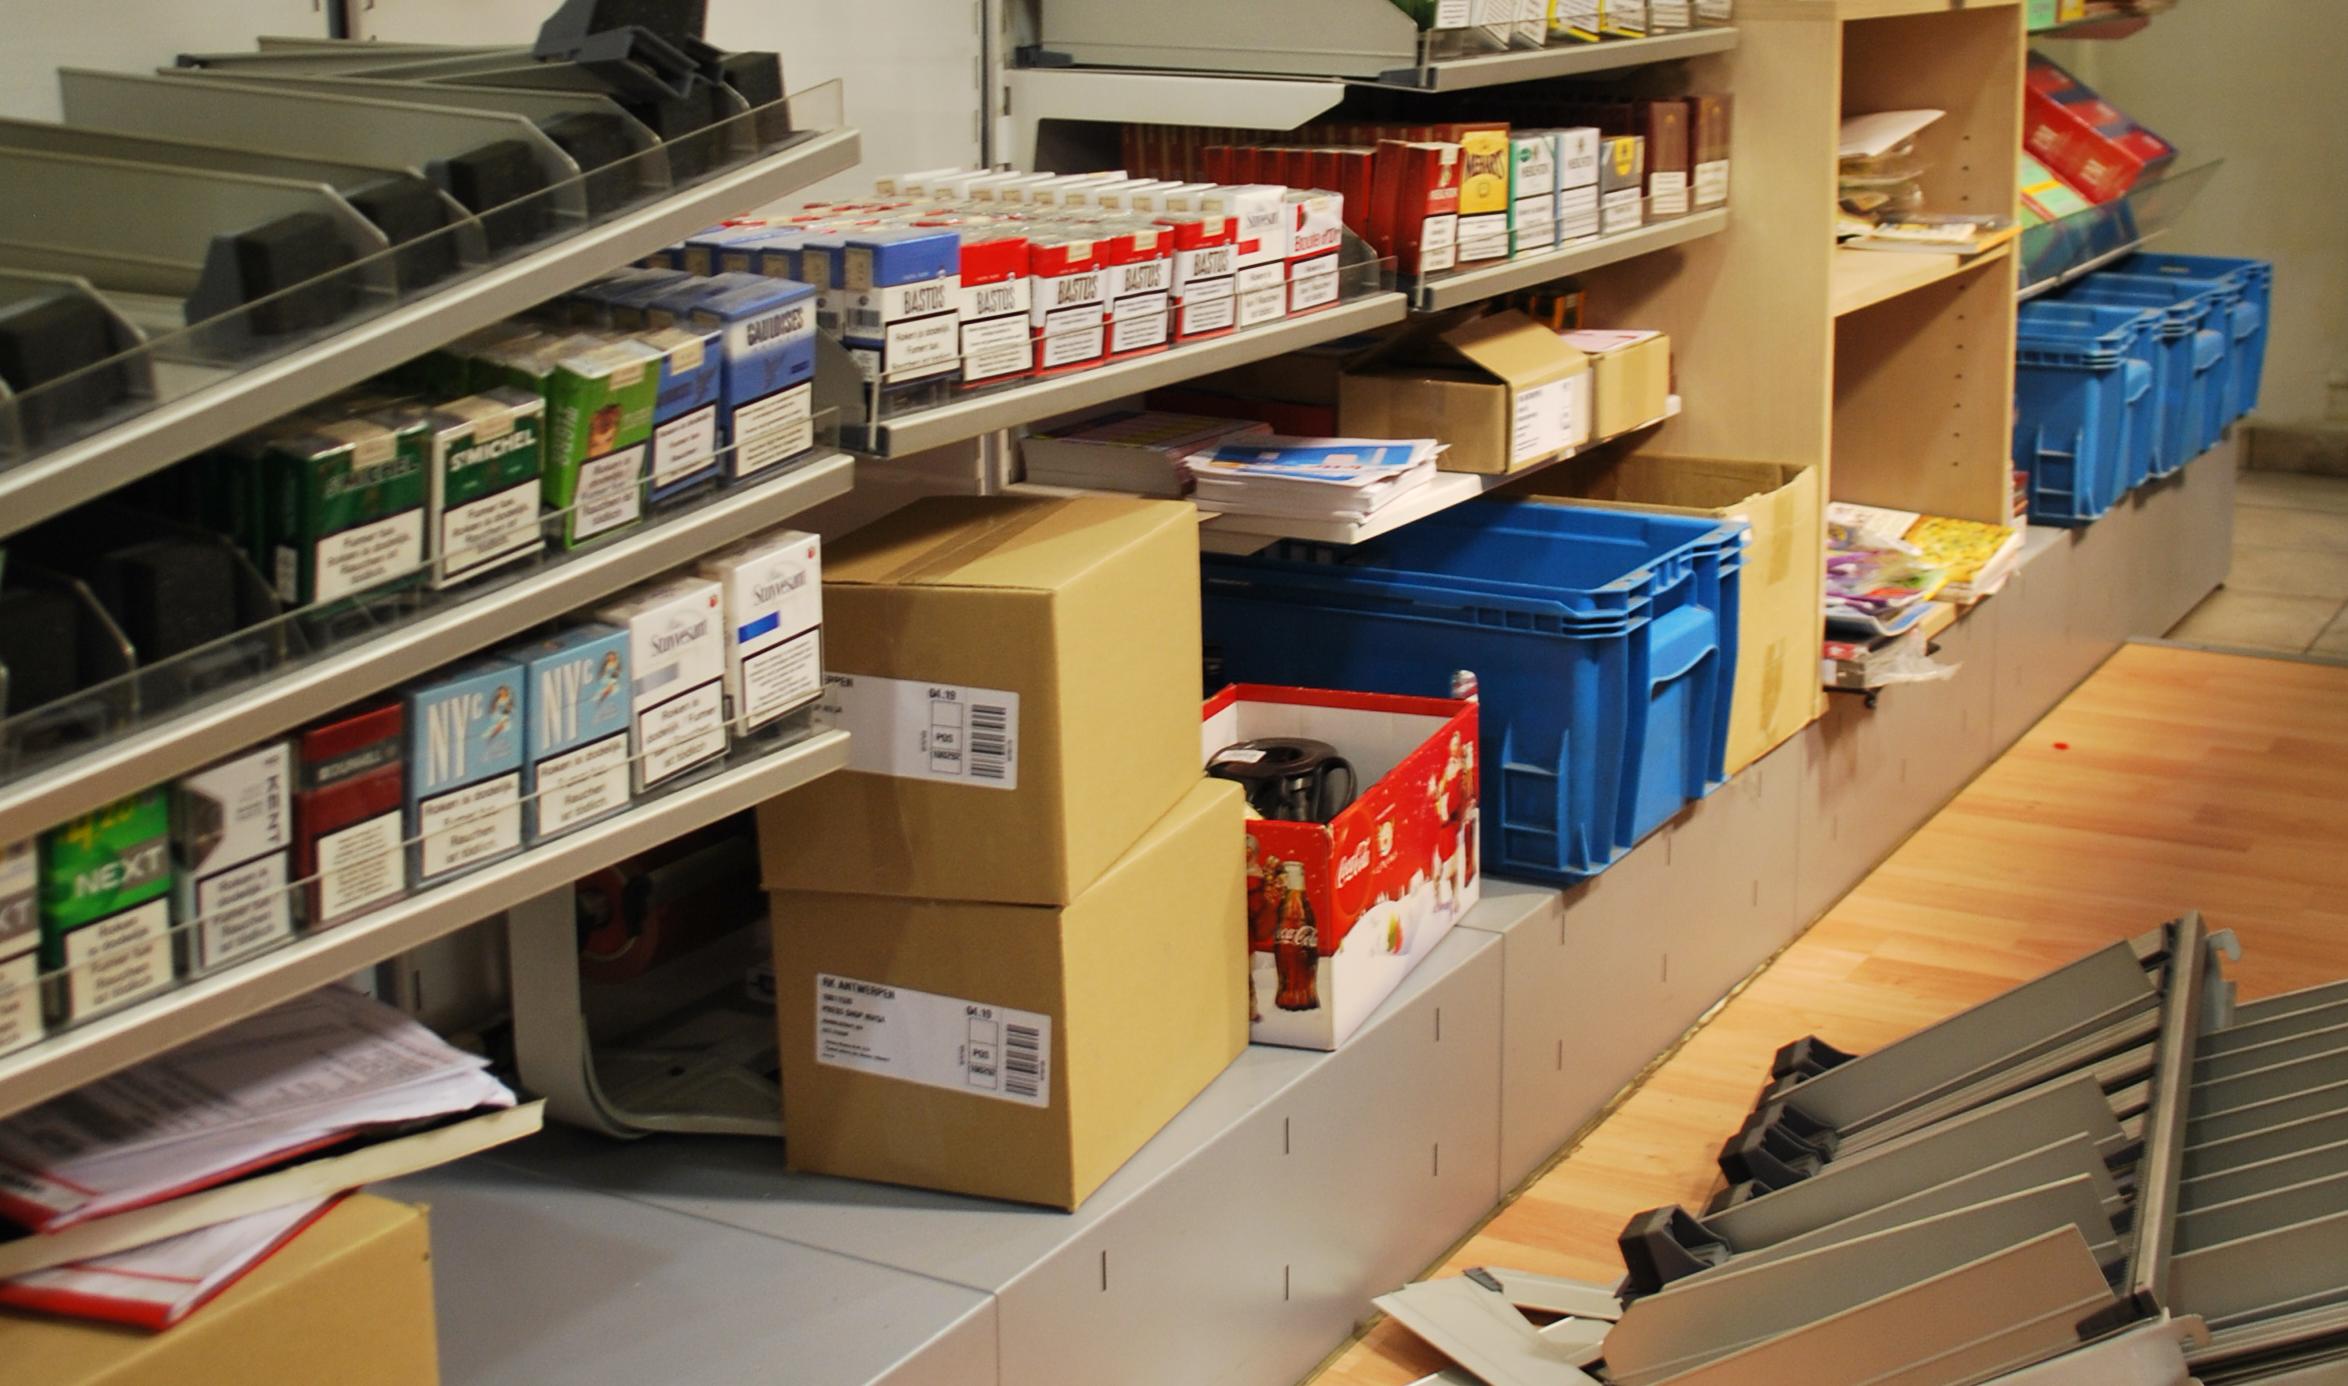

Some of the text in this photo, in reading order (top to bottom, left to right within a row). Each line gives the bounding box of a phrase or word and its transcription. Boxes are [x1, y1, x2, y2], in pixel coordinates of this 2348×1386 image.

[1193, 250, 1229, 276] BASTOS
[1057, 275, 1099, 304] BASTOS
[1125, 264, 1162, 292] BASTOS
[903, 284, 945, 315] BASTOS
[976, 286, 1016, 315] BASTOS
[74, 845, 165, 898] NEXT
